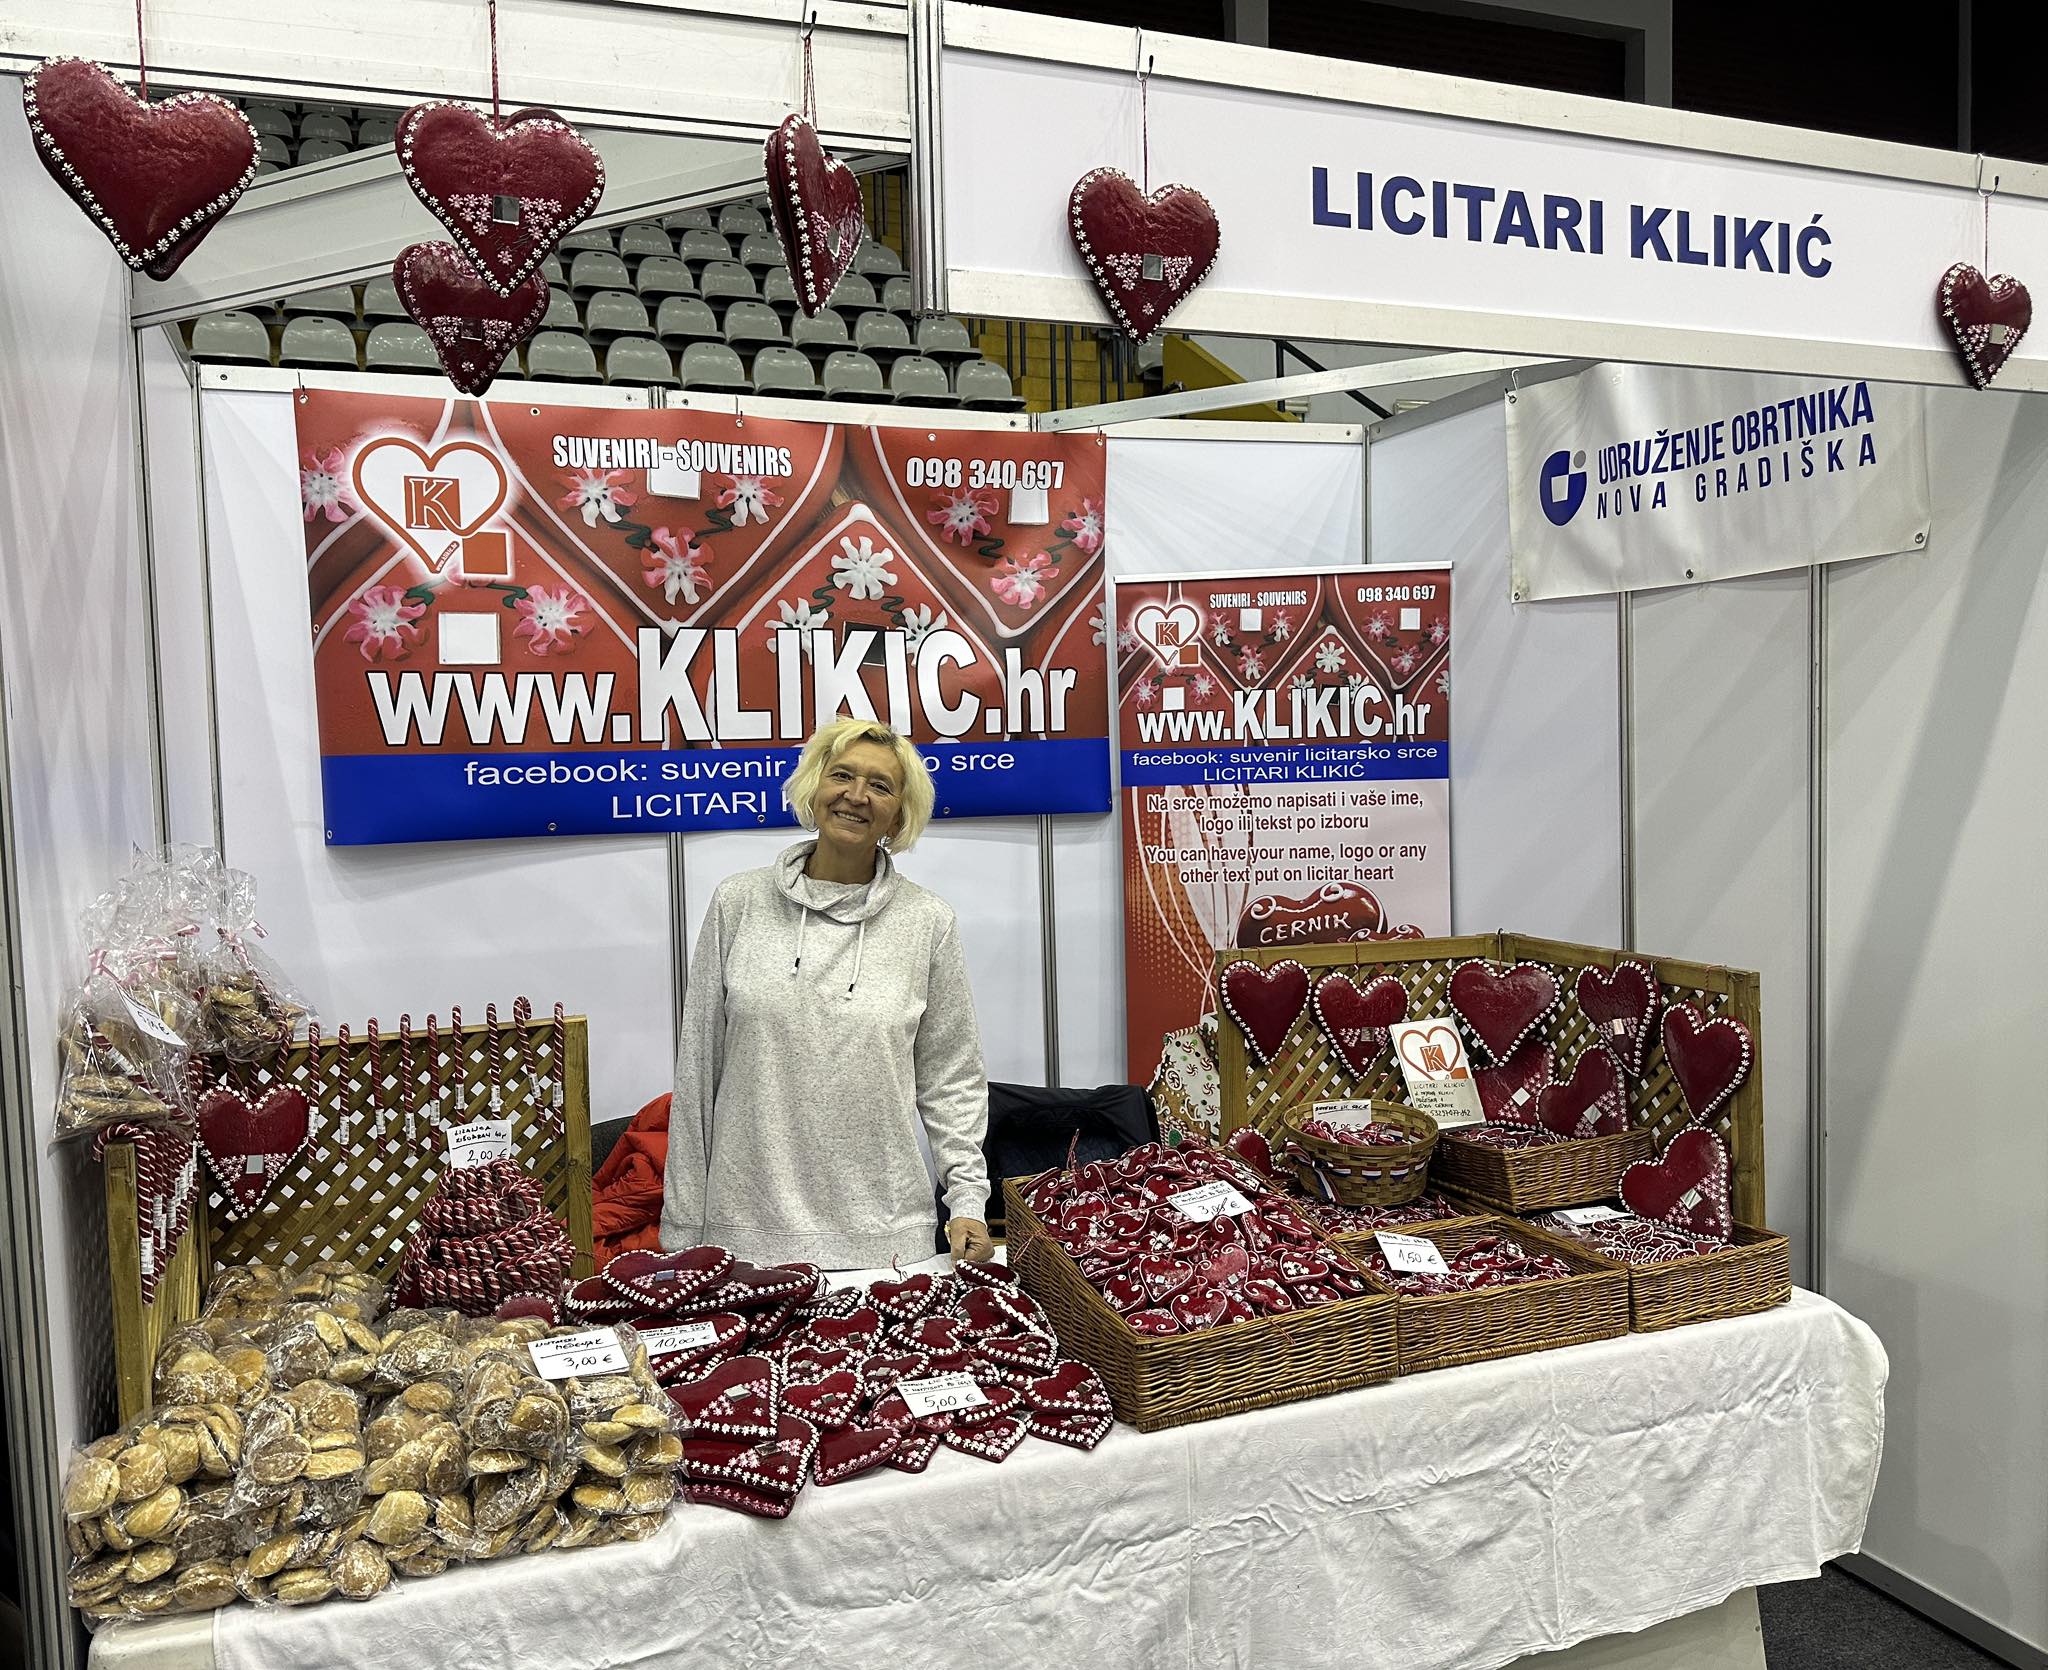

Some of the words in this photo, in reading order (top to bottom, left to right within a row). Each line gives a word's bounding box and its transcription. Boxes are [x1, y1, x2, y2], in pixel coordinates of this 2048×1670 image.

[1312, 166, 1604, 256] LICITARI
[1630, 204, 1833, 279] KLIKIĆ
[1598, 421, 1726, 485] UDRUŽENJE
[1731, 381, 1875, 456] OBRTNIKA
[552, 434, 660, 470] SUVENIRI
[676, 437, 793, 478] SOUVENIRS
[905, 456, 962, 489] 098
[967, 459, 1017, 490] 340
[1019, 460, 1065, 490] 697
[1597, 480, 1668, 520] NOVA
[1694, 432, 1877, 503] GRADIŠKA
[408, 477, 464, 530] K
[1209, 592, 1251, 609] SUVENIRI
[1257, 590, 1308, 607] SOUVENIRS
[1357, 587, 1382, 603] 098
[1385, 586, 1411, 602] 340
[1413, 585, 1437, 601] 697
[1157, 622, 1179, 646] K
[1136, 685, 1431, 744] www.KLIKIC.hr
[1132, 752, 1223, 767] facebook:
[1230, 750, 1300, 764] suvenir
[1304, 747, 1391, 762] licitarsko
[1397, 748, 1438, 760] srce
[464, 760, 648, 785] facebook:
[660, 756, 787, 782] suvenir
[950, 753, 1015, 771] srce
[1203, 767, 1289, 782] LICITARI
[1295, 761, 1366, 780] KLIKIĆ
[612, 791, 768, 820] LICITARI
[1147, 795, 1169, 811] Na
[1172, 797, 1205, 811] srce
[1208, 792, 1273, 810] možemo
[1276, 791, 1336, 812] napisati
[1341, 790, 1346, 806] i
[1350, 789, 1387, 807] vaše
[1390, 790, 1424, 808] ime,
[1200, 816, 1234, 835] logo
[1238, 815, 1251, 831] ili
[1254, 815, 1292, 831] tekst
[1297, 818, 1316, 835] po
[1320, 814, 1369, 830] izboru
[1146, 846, 1176, 863] You
[1180, 848, 1208, 862] can
[1211, 845, 1248, 861] have
[1249, 848, 1284, 865] your
[1288, 845, 1335, 861] name,
[1339, 843, 1375, 861] logo
[1379, 845, 1396, 858] or
[1399, 844, 1427, 862] any
[1180, 868, 1218, 884] other
[1222, 868, 1251, 883] text
[1254, 868, 1280, 885] put
[1283, 869, 1302, 882] on
[1306, 866, 1350, 881] licitar
[1353, 864, 1394, 881] heart
[1259, 911, 1352, 945] CERNIK
[467, 1149, 493, 1165] 2,00
[1399, 1248, 1422, 1264] 1,50
[1427, 1254, 1438, 1265] €
[654, 1337, 695, 1349] 10,00
[563, 1356, 597, 1370] 3,00
[602, 1354, 613, 1364] €
[924, 1394, 957, 1412] 5,00
[965, 1393, 976, 1403] €
